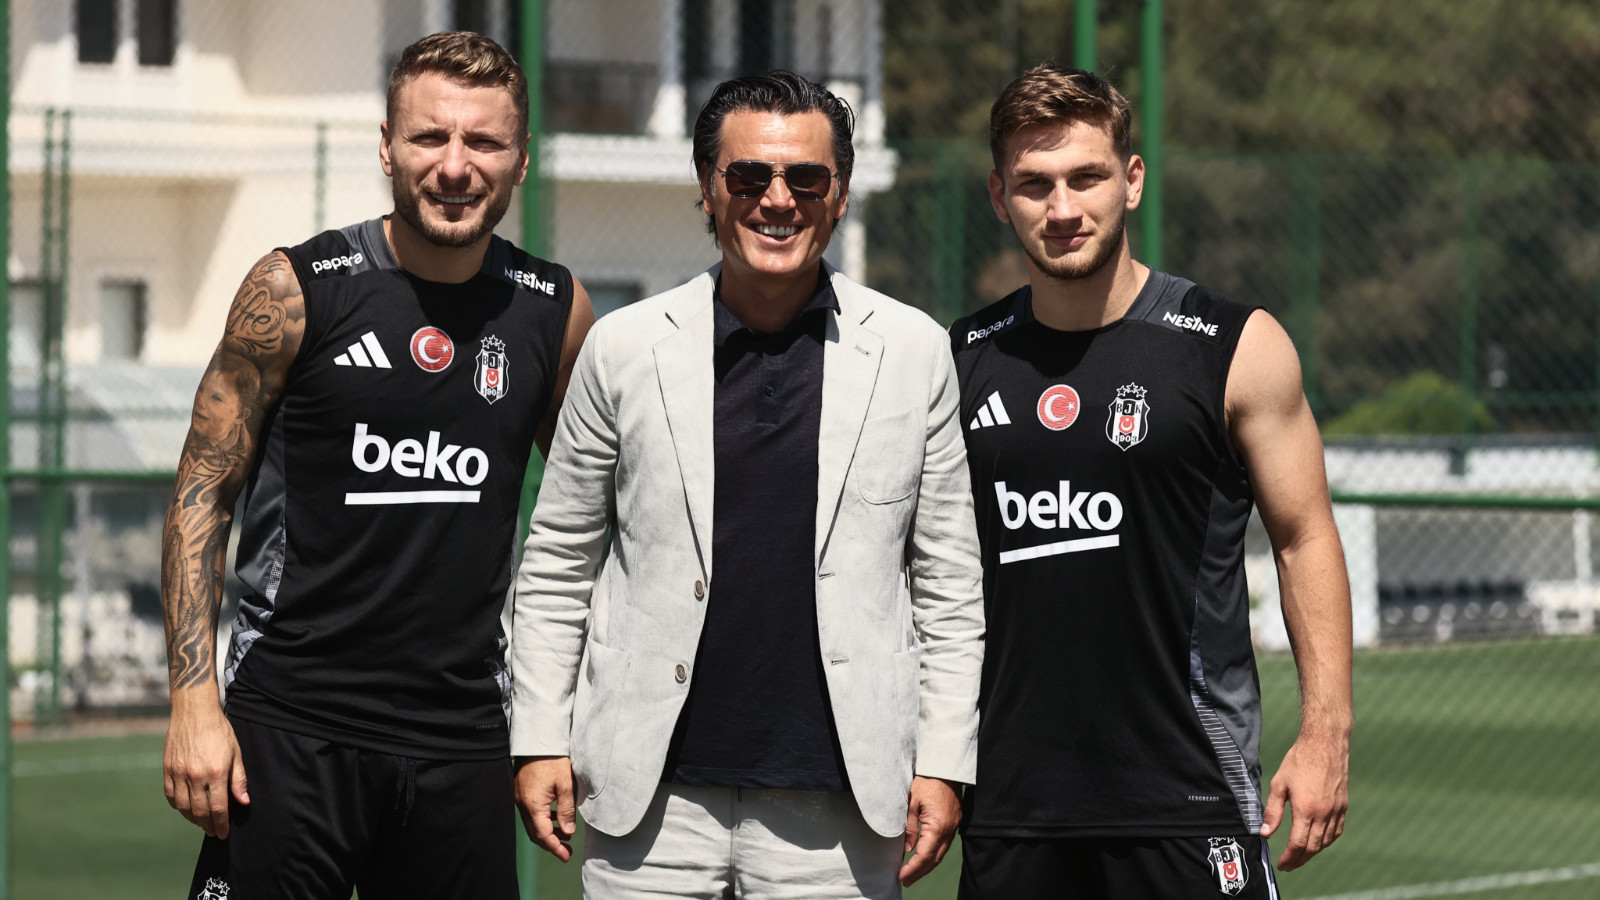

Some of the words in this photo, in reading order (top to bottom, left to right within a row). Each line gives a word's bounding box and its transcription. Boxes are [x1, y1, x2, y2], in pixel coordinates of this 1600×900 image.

[312, 252, 363, 274] papara
[967, 315, 1015, 344] papara
[482, 355, 503, 368] BJK
[483, 387, 502, 397] 1903
[1116, 403, 1142, 414] BJK
[1115, 434, 1138, 443] 1903
[352, 422, 489, 486] beko
[994, 480, 1123, 531] beko
[1215, 848, 1240, 863] BJK
[1223, 880, 1244, 891] 1903
